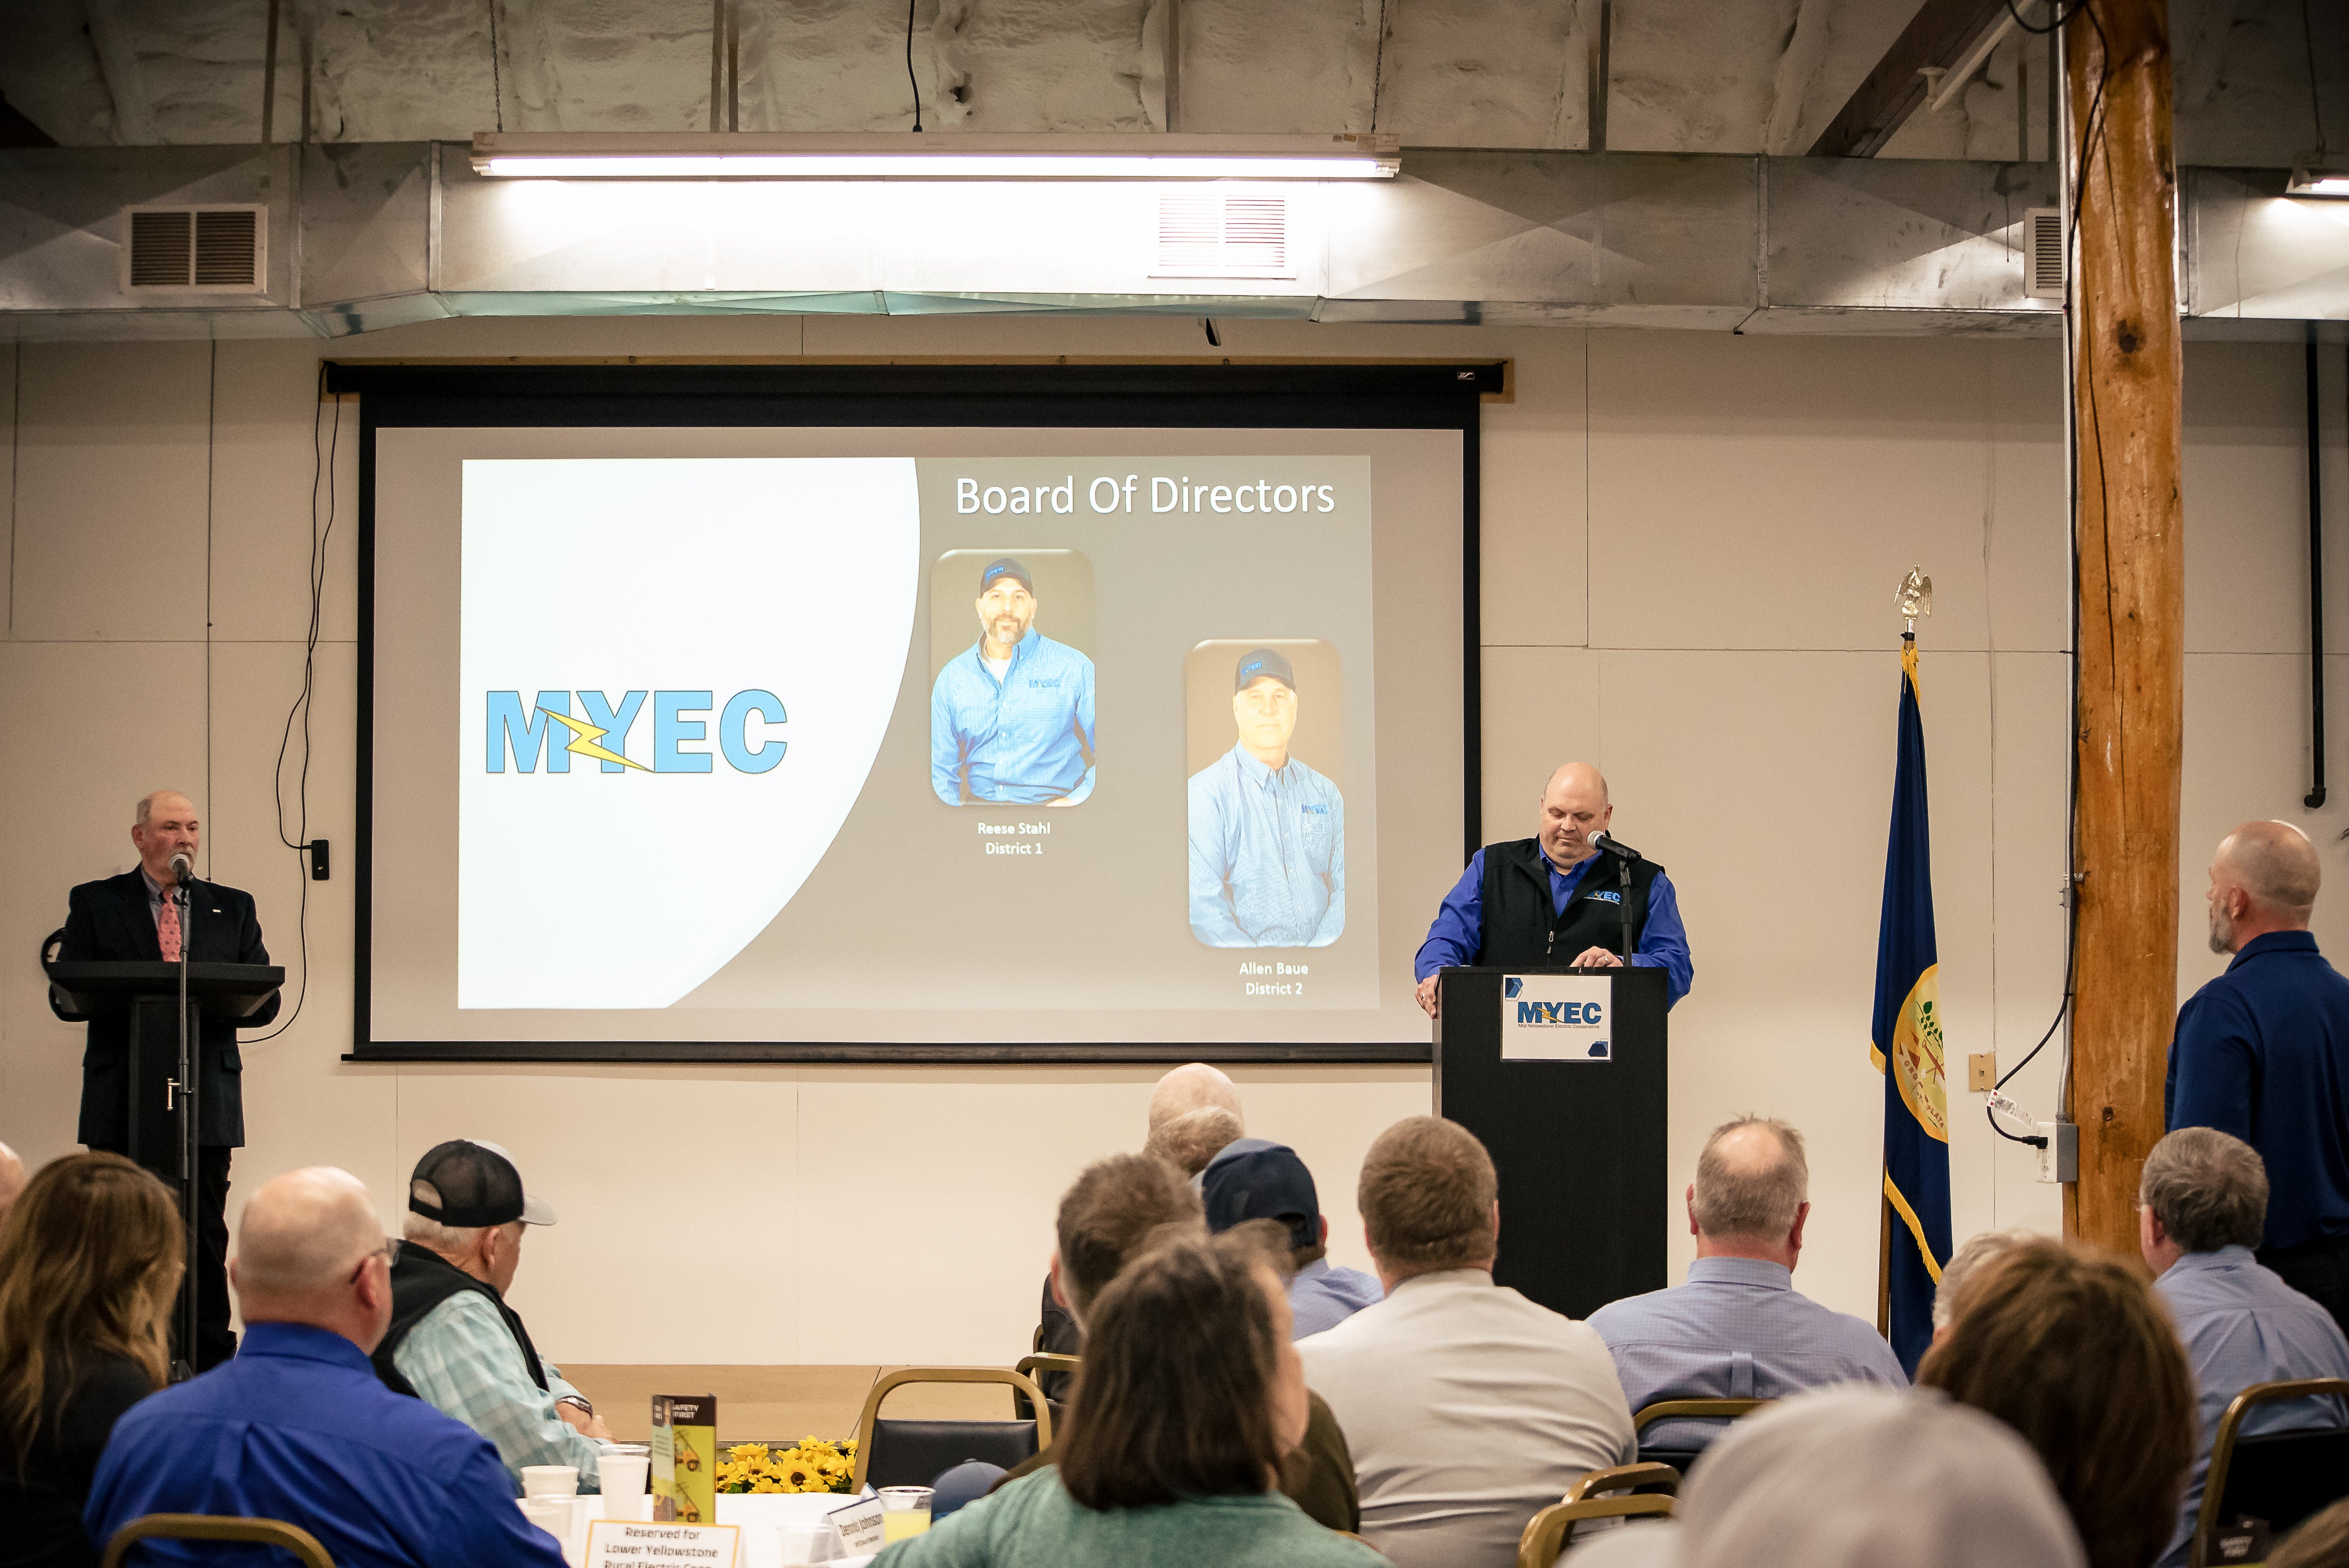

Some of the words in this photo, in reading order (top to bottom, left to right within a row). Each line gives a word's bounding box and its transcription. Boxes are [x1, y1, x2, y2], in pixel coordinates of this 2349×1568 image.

[956, 475, 1074, 514] Board
[1088, 474, 1139, 514] Of
[1151, 476, 1335, 514] Directors
[486, 689, 788, 774] MYEC
[978, 822, 1016, 834] Reese
[1018, 821, 1051, 834] Stahl
[986, 841, 1032, 855] District
[1035, 842, 1043, 855] 1
[1239, 961, 1272, 975] Allen
[1276, 962, 1309, 975] Baue
[1246, 981, 1292, 995] District
[1295, 982, 1303, 995] 2
[1518, 1002, 1602, 1024] MYEC
[839, 1520, 860, 1537] Dennis
[859, 1513, 885, 1533] Johnson
[625, 1526, 681, 1539] Reserved
[683, 1529, 701, 1540] for
[605, 1543, 642, 1555] Lower
[646, 1544, 719, 1558] Yellowstone
